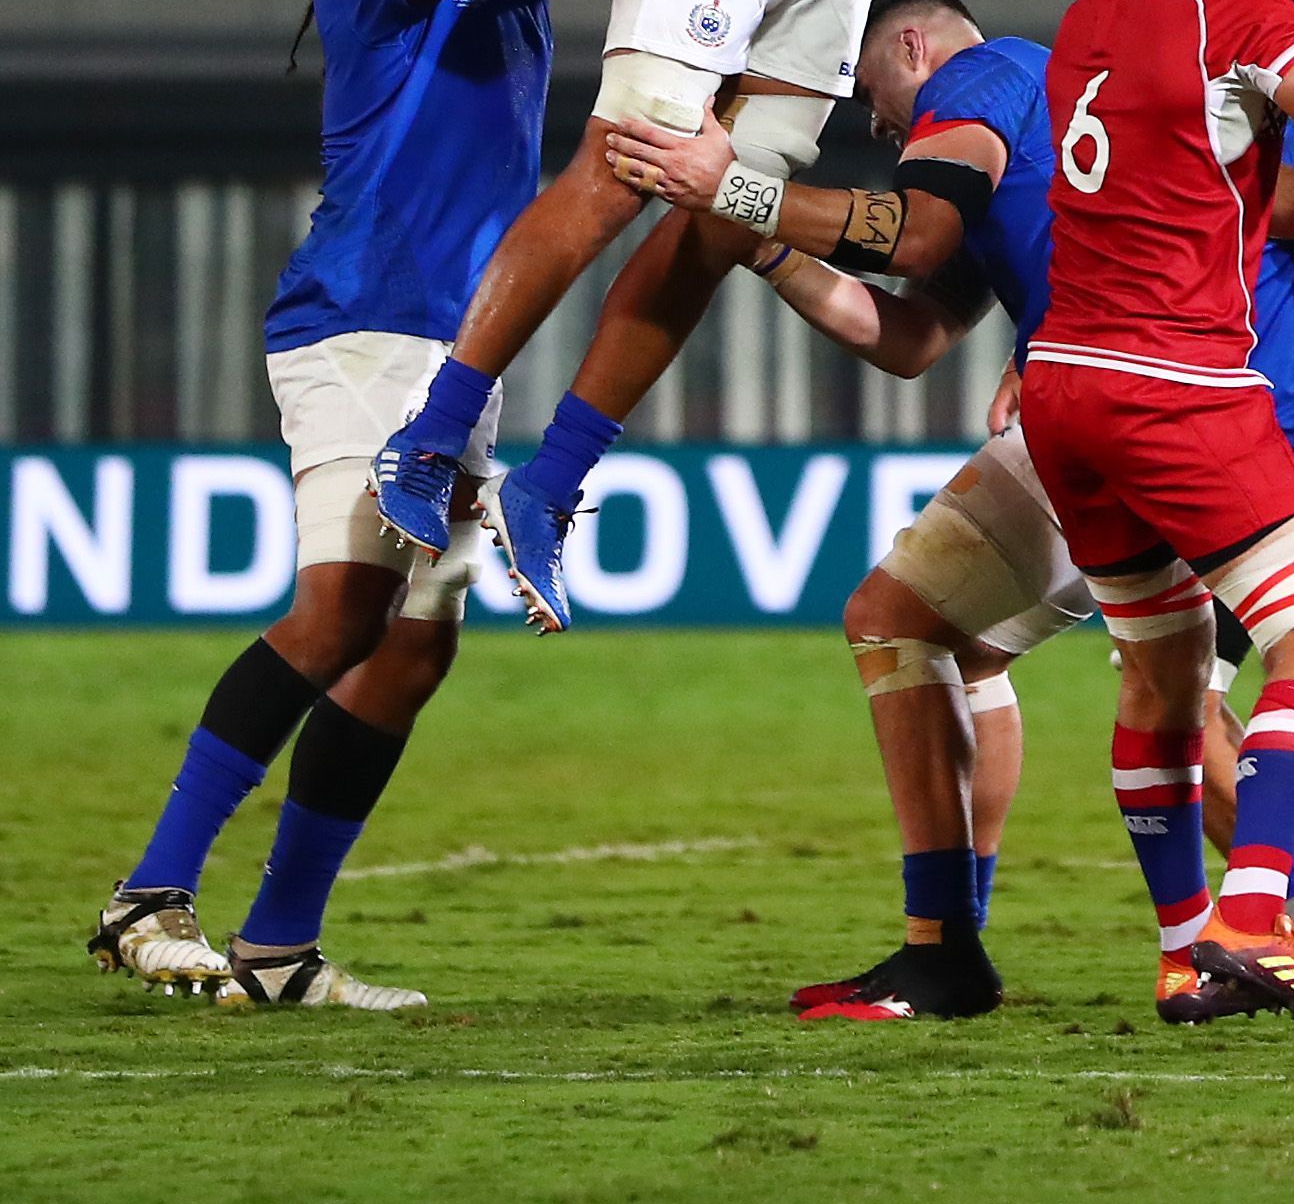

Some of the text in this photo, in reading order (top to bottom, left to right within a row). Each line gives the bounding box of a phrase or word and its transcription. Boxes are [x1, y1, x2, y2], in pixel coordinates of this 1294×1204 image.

[1061, 69, 1110, 194] 6
[729, 175, 777, 205] 056
[720, 192, 774, 224] BEK
